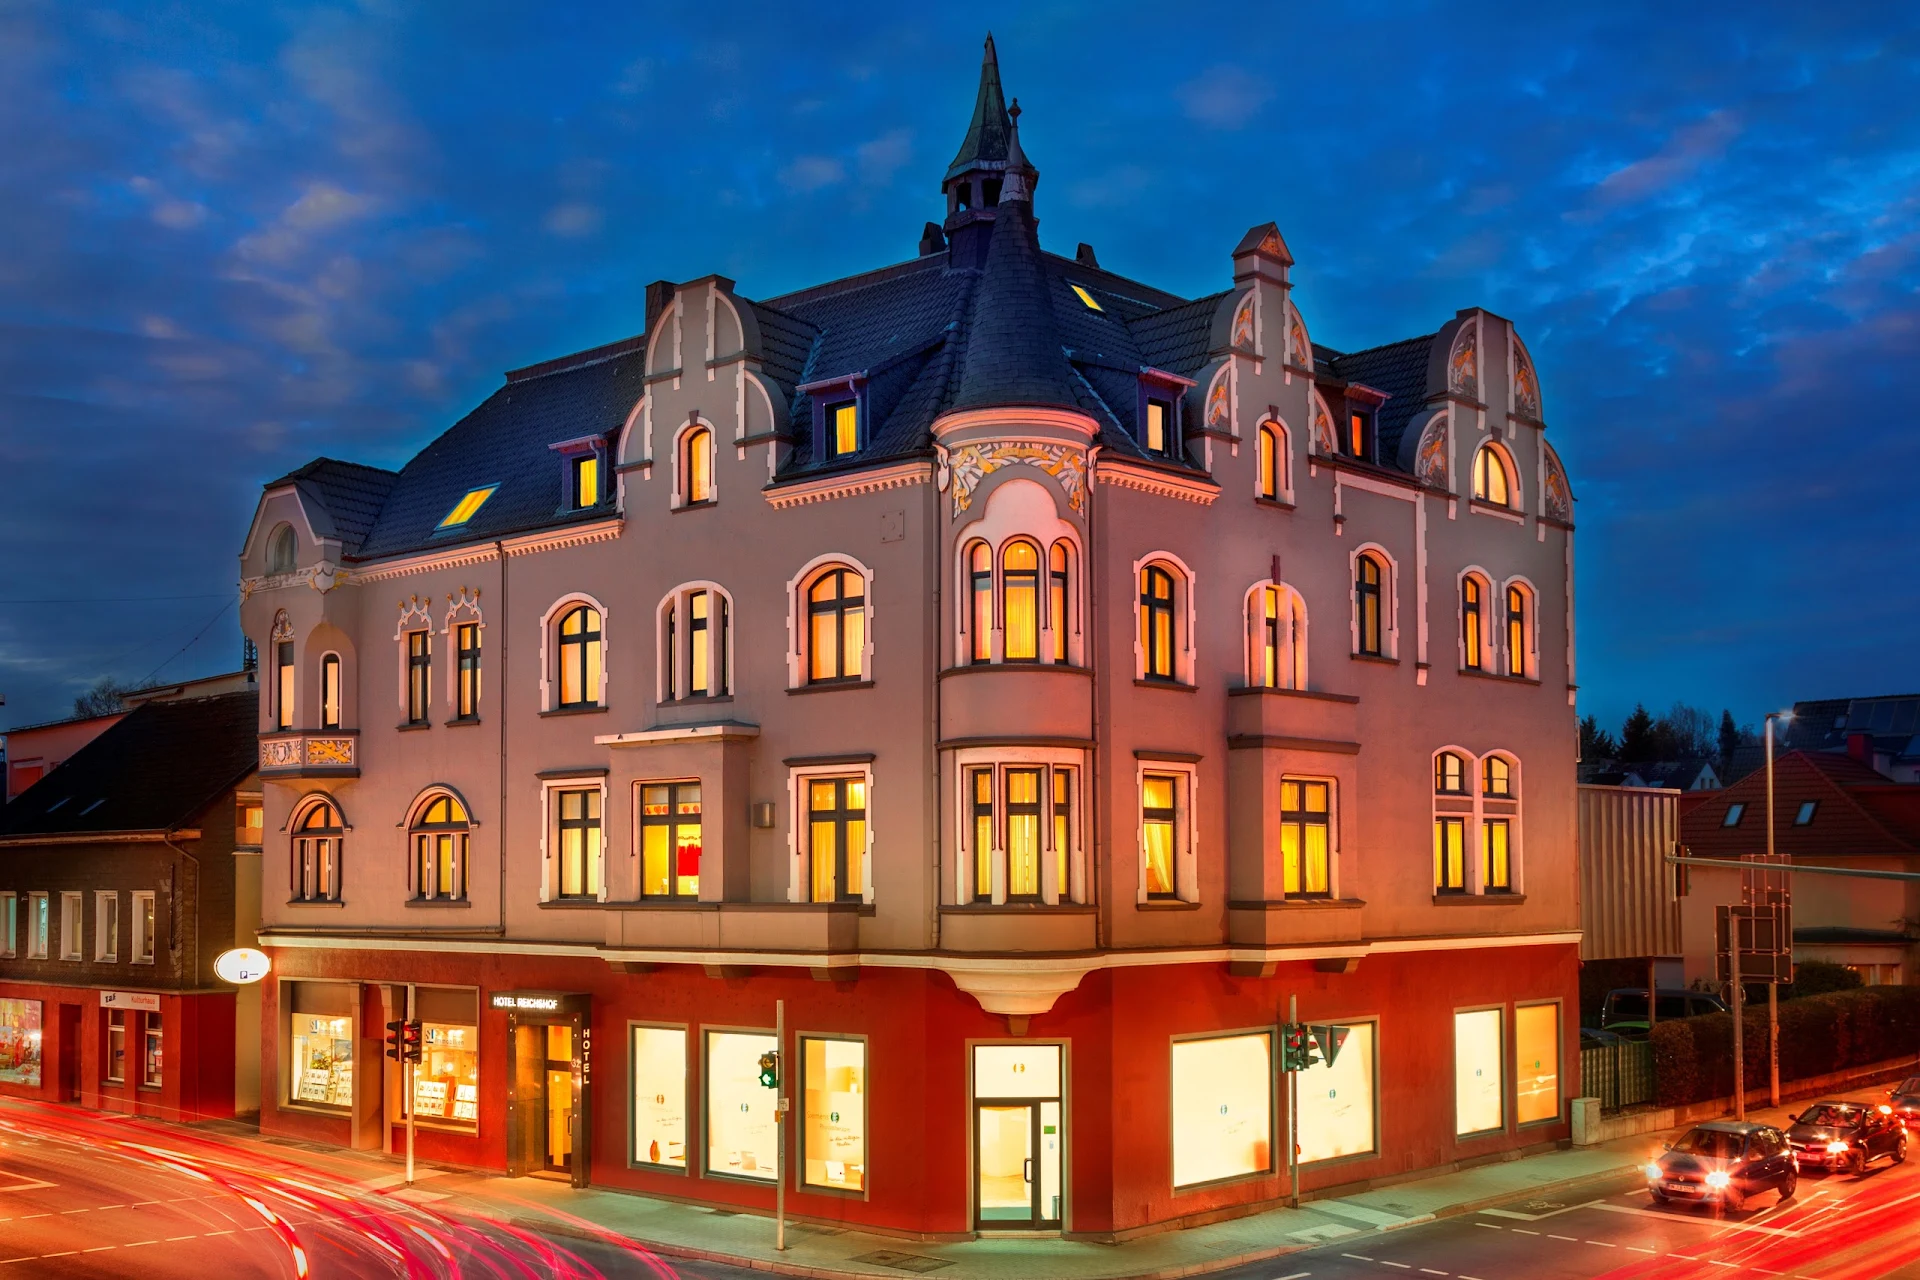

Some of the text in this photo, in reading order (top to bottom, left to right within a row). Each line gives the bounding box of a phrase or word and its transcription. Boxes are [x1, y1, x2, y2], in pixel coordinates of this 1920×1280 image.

[493, 997, 558, 1010] HOTEL REICHSHOF
[582, 1028, 591, 1085] HOTEL
